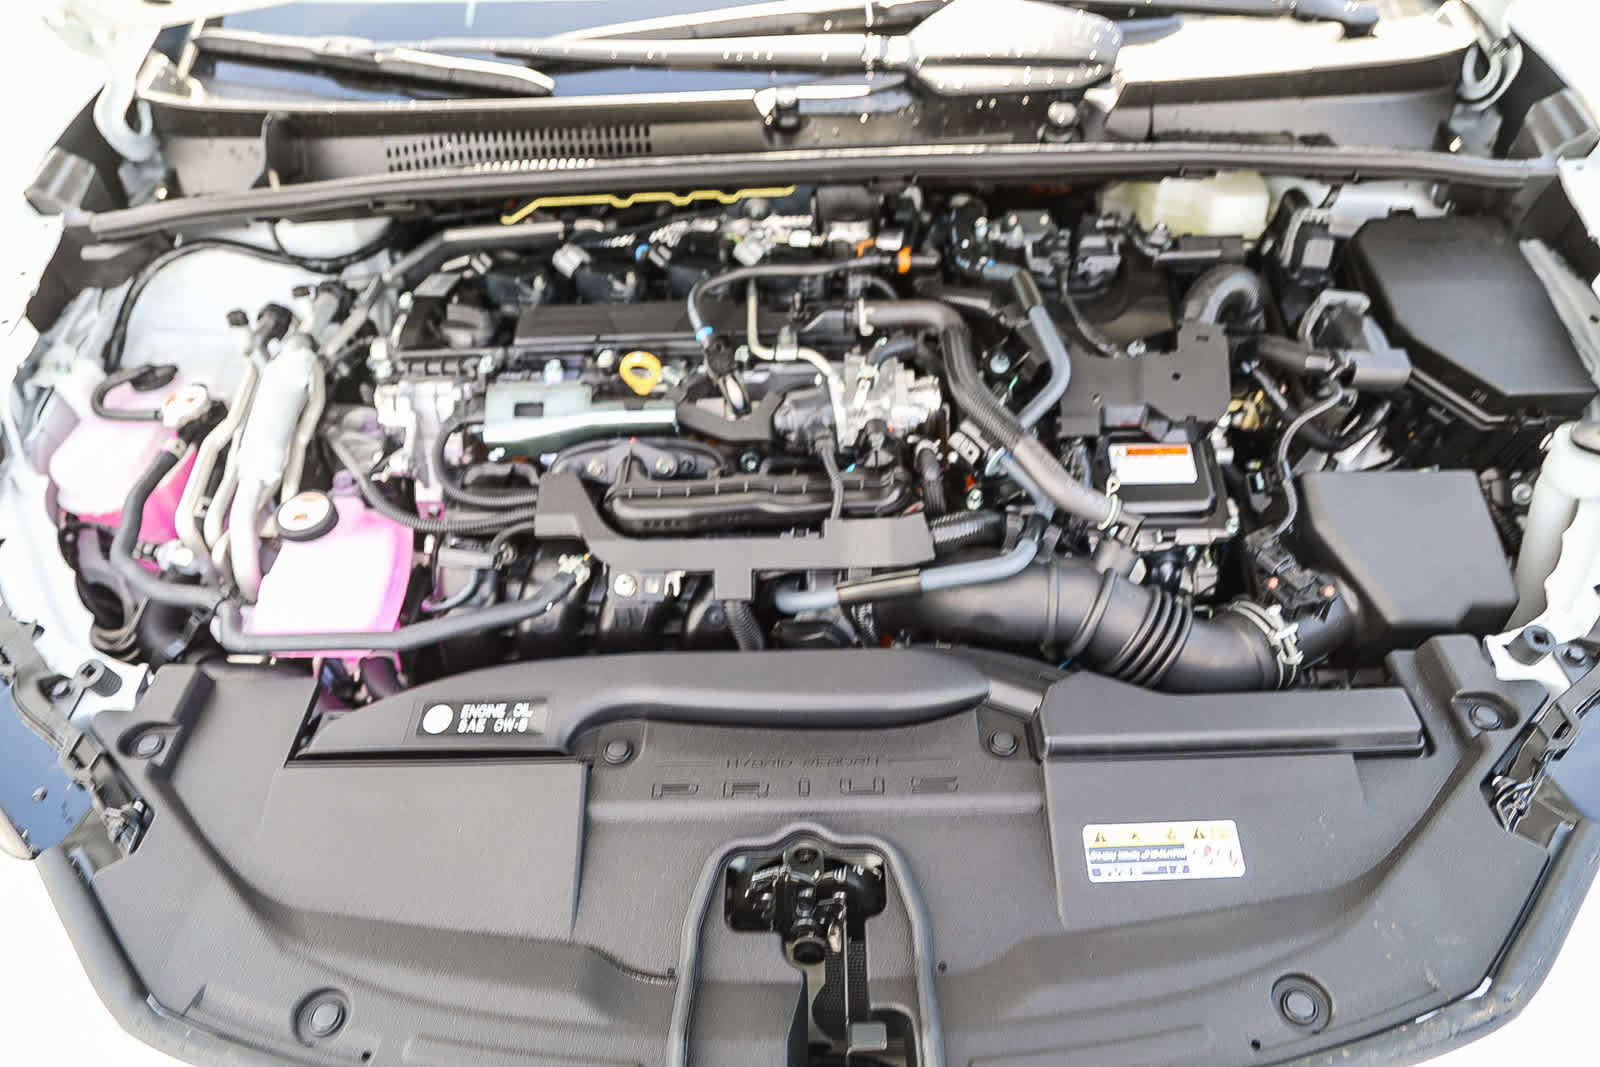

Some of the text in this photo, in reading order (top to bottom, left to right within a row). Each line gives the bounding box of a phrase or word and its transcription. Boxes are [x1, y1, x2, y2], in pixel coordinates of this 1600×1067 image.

[460, 702, 533, 719] ENGINE OIL
[457, 718, 487, 734] SAE
[651, 776, 959, 799] PRIUS
